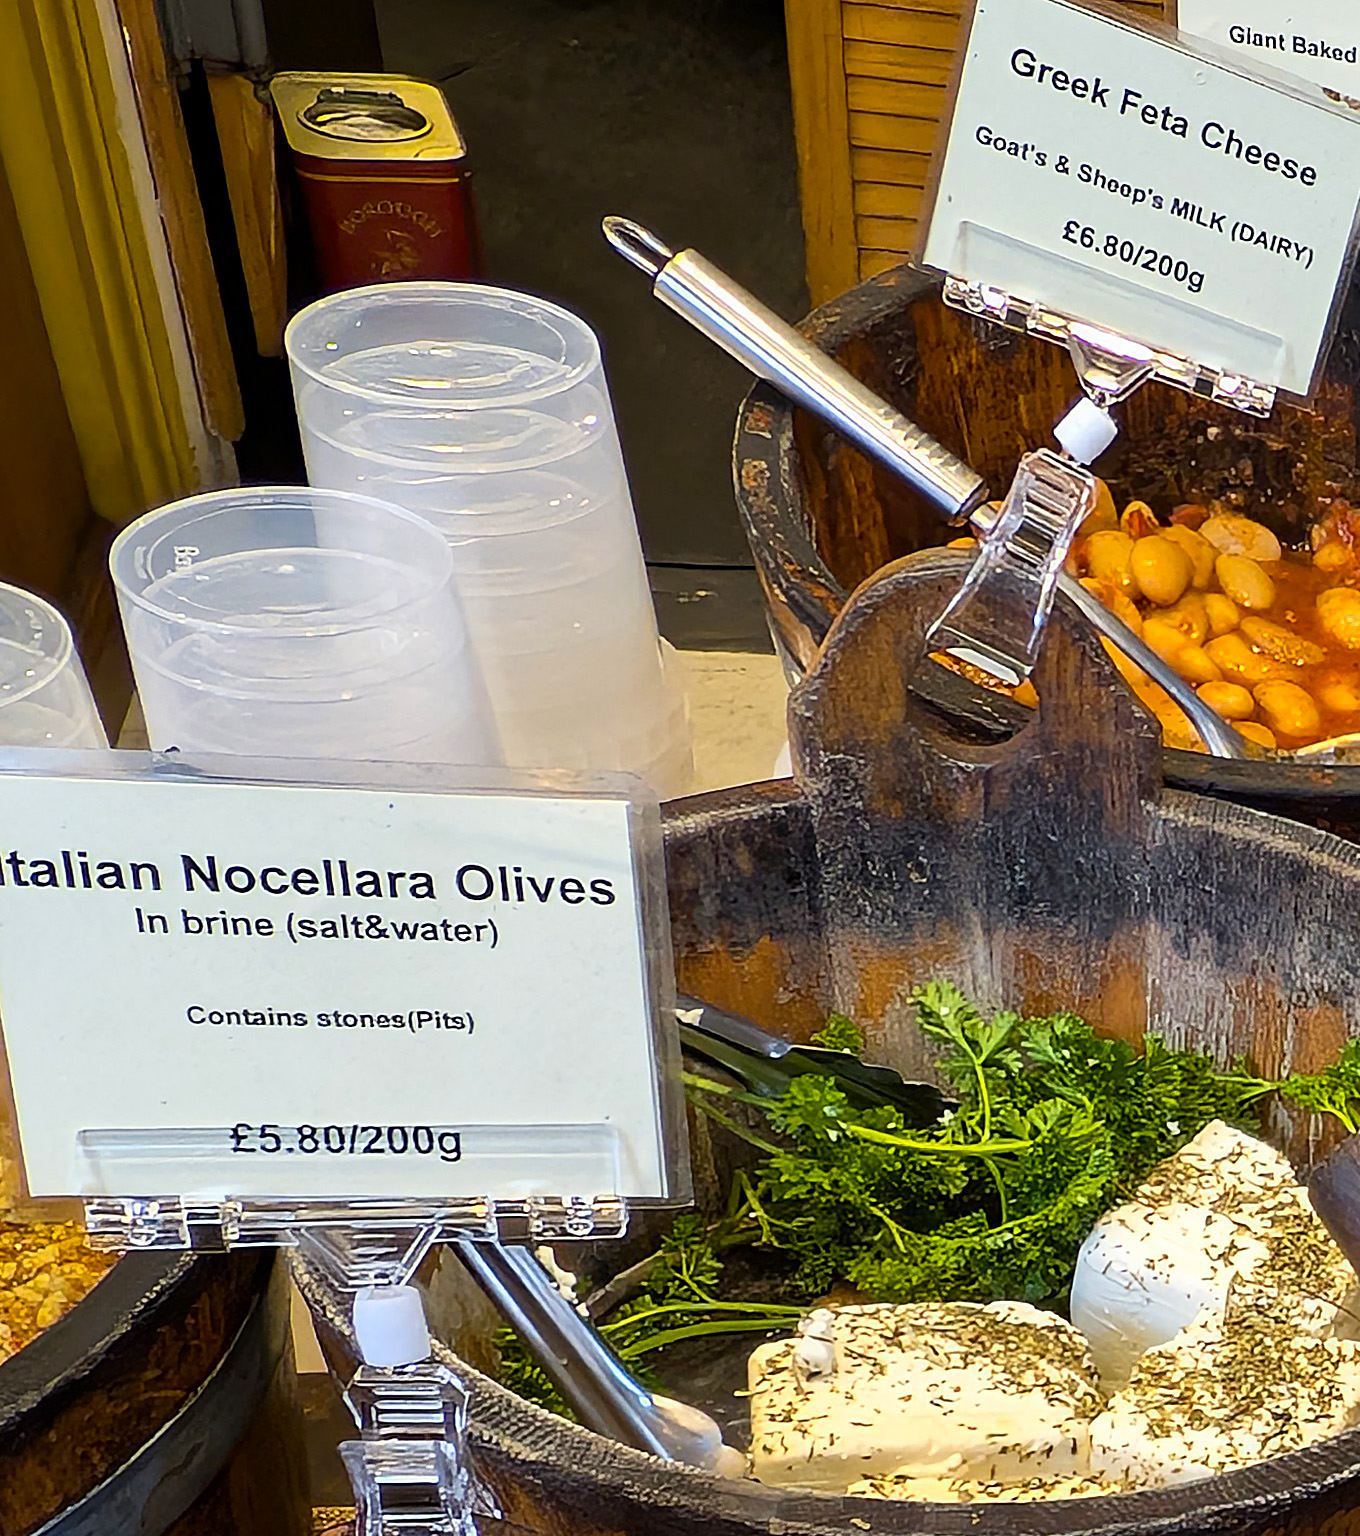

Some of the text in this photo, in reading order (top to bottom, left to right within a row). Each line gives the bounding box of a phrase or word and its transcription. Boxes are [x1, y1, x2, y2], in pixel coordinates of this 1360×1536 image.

[1229, 25, 1286, 52] Giant
[1292, 35, 1357, 64] Baked
[1010, 48, 1317, 187] Greek Feta Cheese
[975, 126, 1314, 270] Goat's & Sheep's MILK (DAIRY)
[1062, 220, 1205, 293] £6.80/200g
[180, 854, 437, 900] Nocellara
[455, 864, 616, 906] Olives
[135, 907, 499, 949] In brine (salt&water)
[186, 1005, 475, 1035] Contains stones(Pits)
[229, 1122, 462, 1163] £5.80/200g
